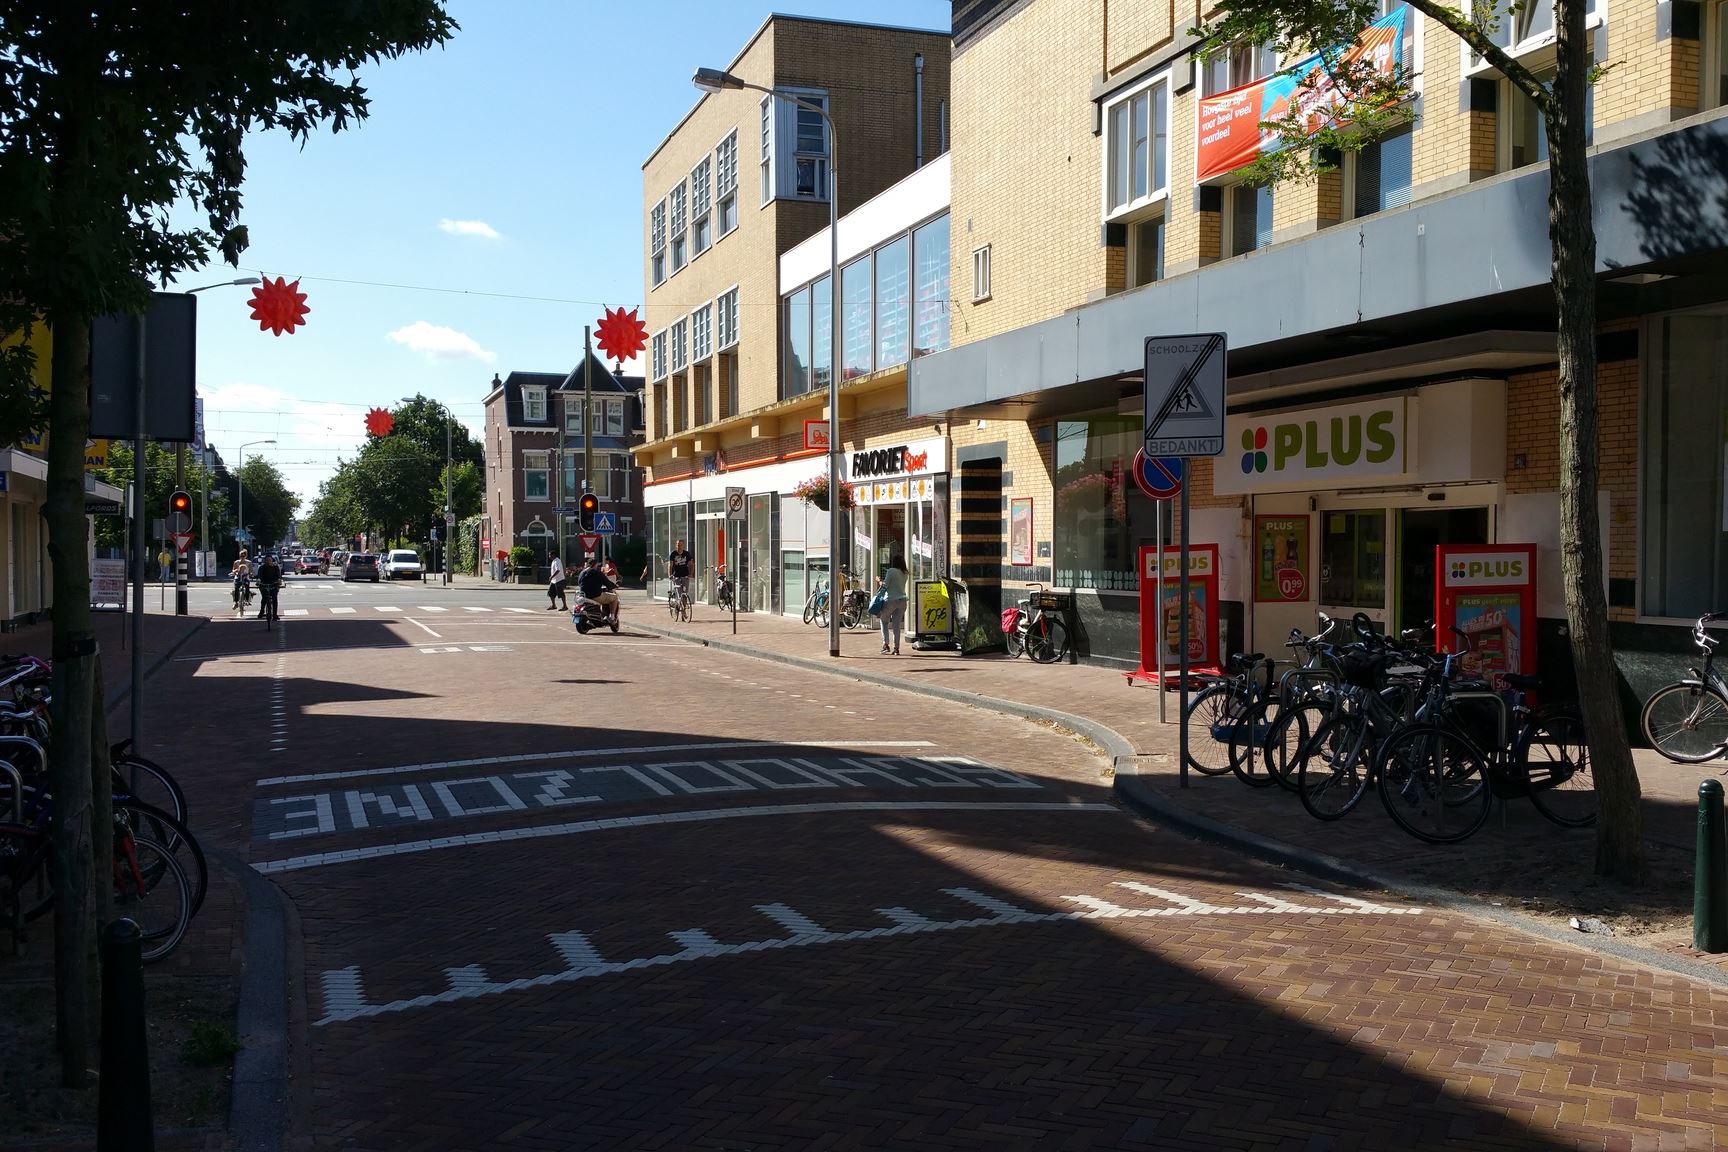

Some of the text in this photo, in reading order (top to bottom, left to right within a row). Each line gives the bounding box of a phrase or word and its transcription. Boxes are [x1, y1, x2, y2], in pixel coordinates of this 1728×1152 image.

[1202, 119, 1216, 131] voor
[1218, 112, 1233, 124] heel
[1234, 103, 1252, 118] veel
[1201, 128, 1230, 146] voordeel
[1150, 440, 1218, 453] BEDANKT!
[1274, 410, 1396, 471] PLUS
[852, 445, 908, 478] FAVORIET
[1266, 521, 1293, 530] PLUS
[1469, 561, 1523, 578] PLUS
[269, 756, 1044, 840] SCHOOLZONE
